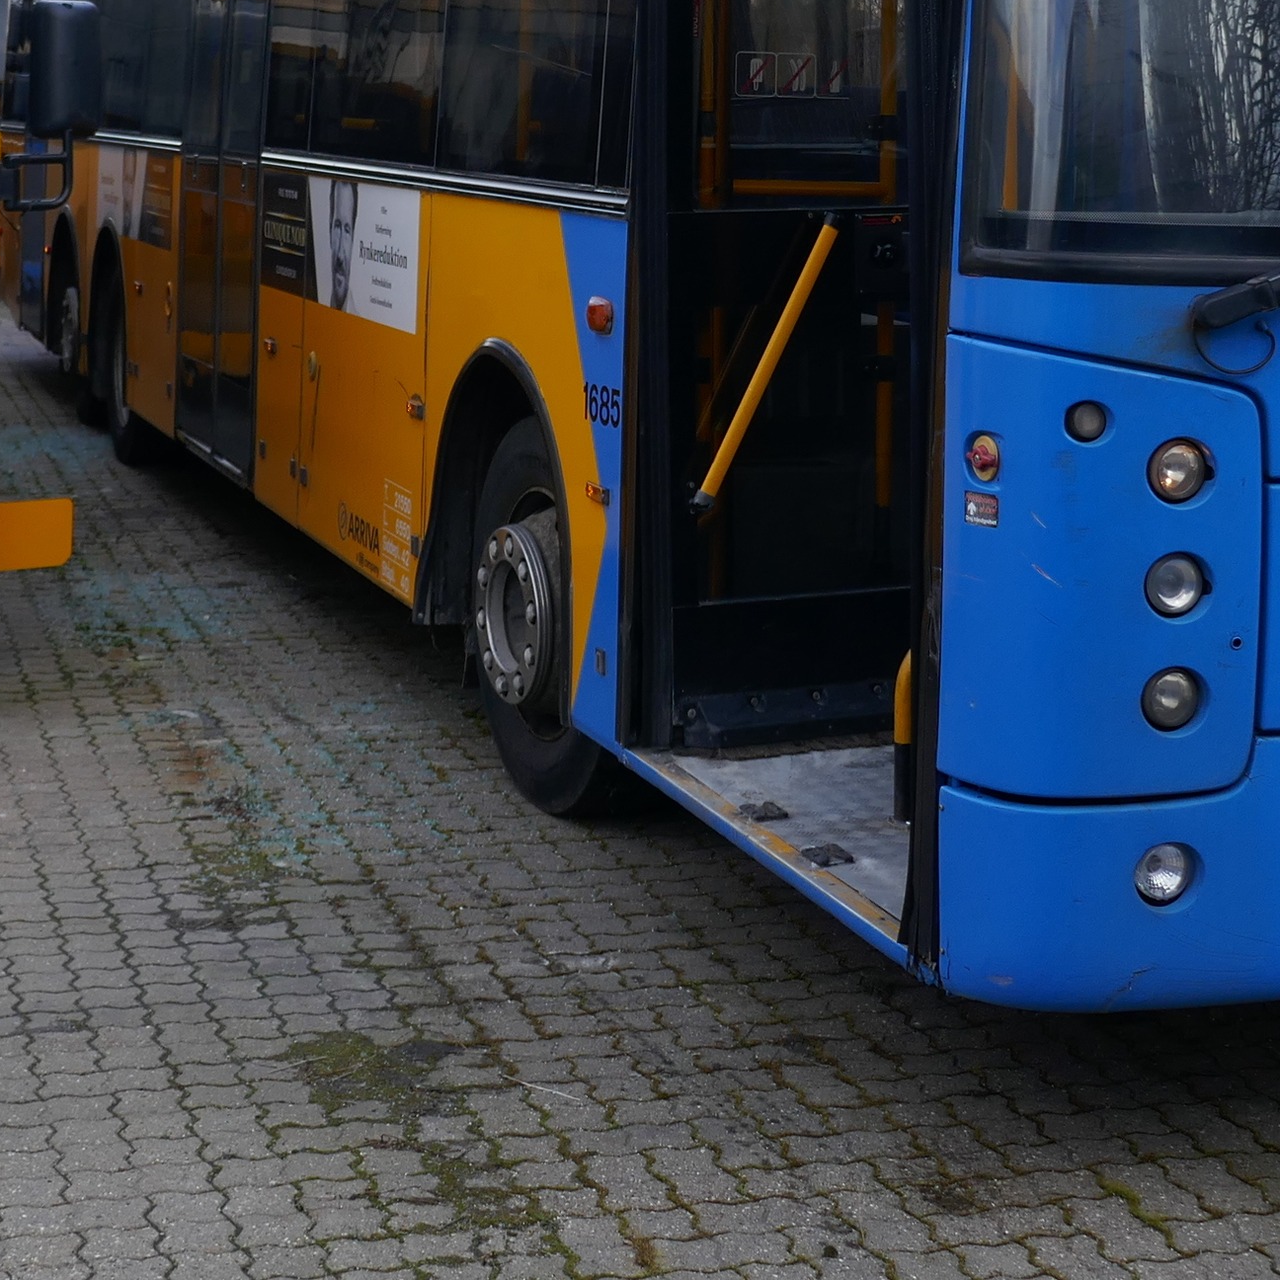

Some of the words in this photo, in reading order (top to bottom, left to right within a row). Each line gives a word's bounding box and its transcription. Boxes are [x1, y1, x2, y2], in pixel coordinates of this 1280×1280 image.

[359, 240, 408, 269] Rynkereduktion
[583, 381, 620, 428] 1685
[347, 512, 380, 558] ARRIVA
